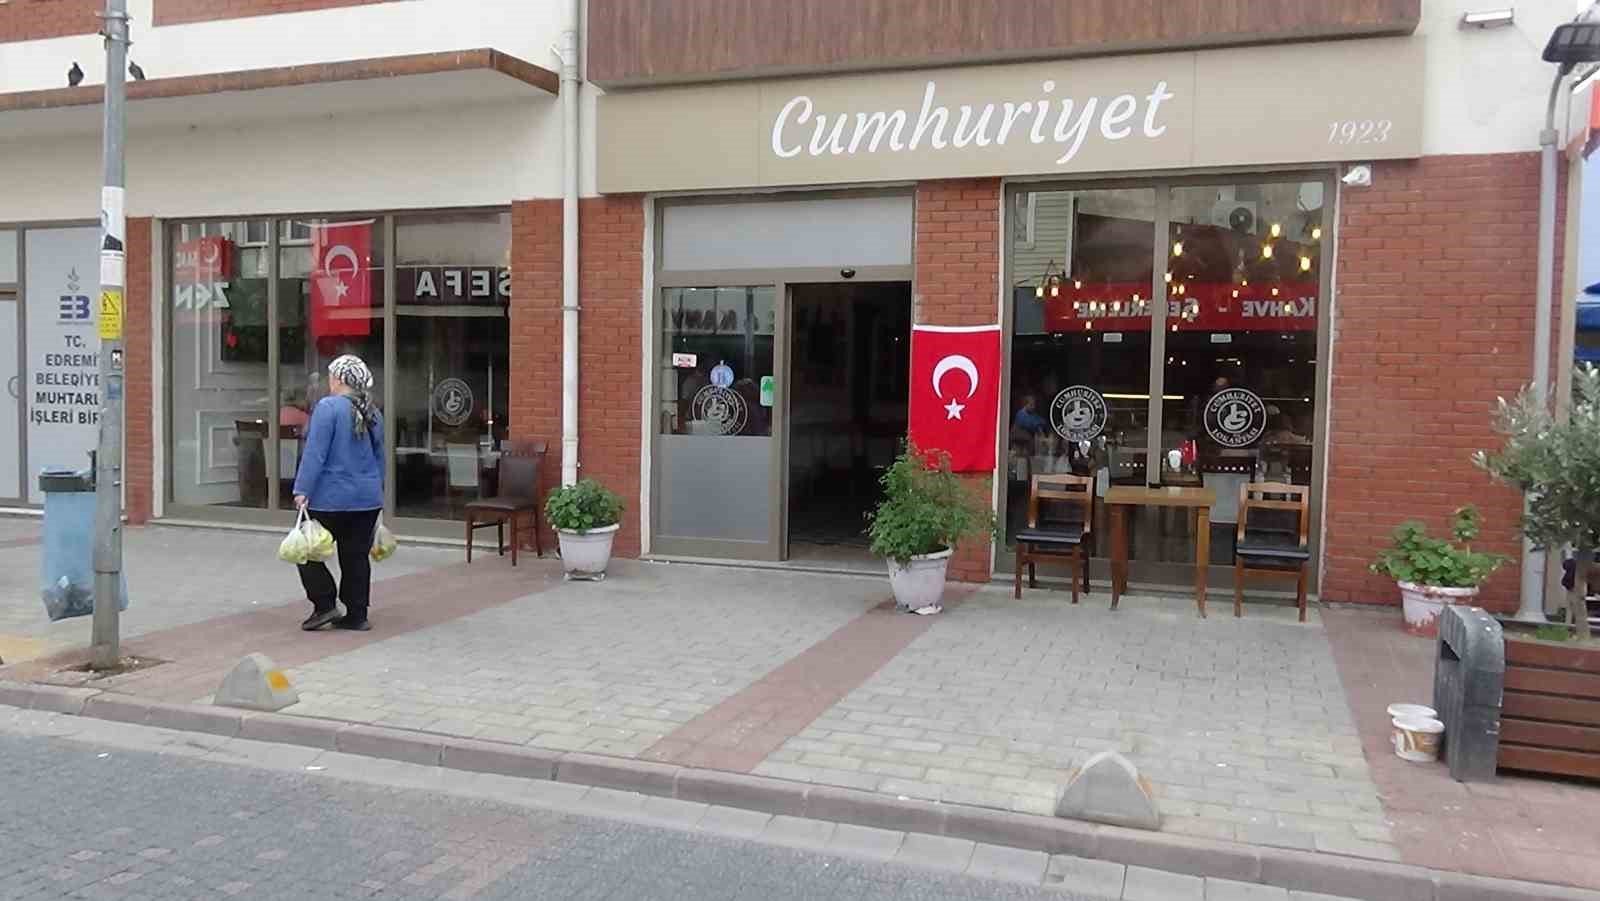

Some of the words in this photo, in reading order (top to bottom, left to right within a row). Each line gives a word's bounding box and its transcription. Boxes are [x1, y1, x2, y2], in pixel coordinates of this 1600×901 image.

[771, 80, 1175, 164] Cumhuriyet
[1327, 119, 1393, 144] 1923
[31, 408, 73, 425] İŞLERİ
